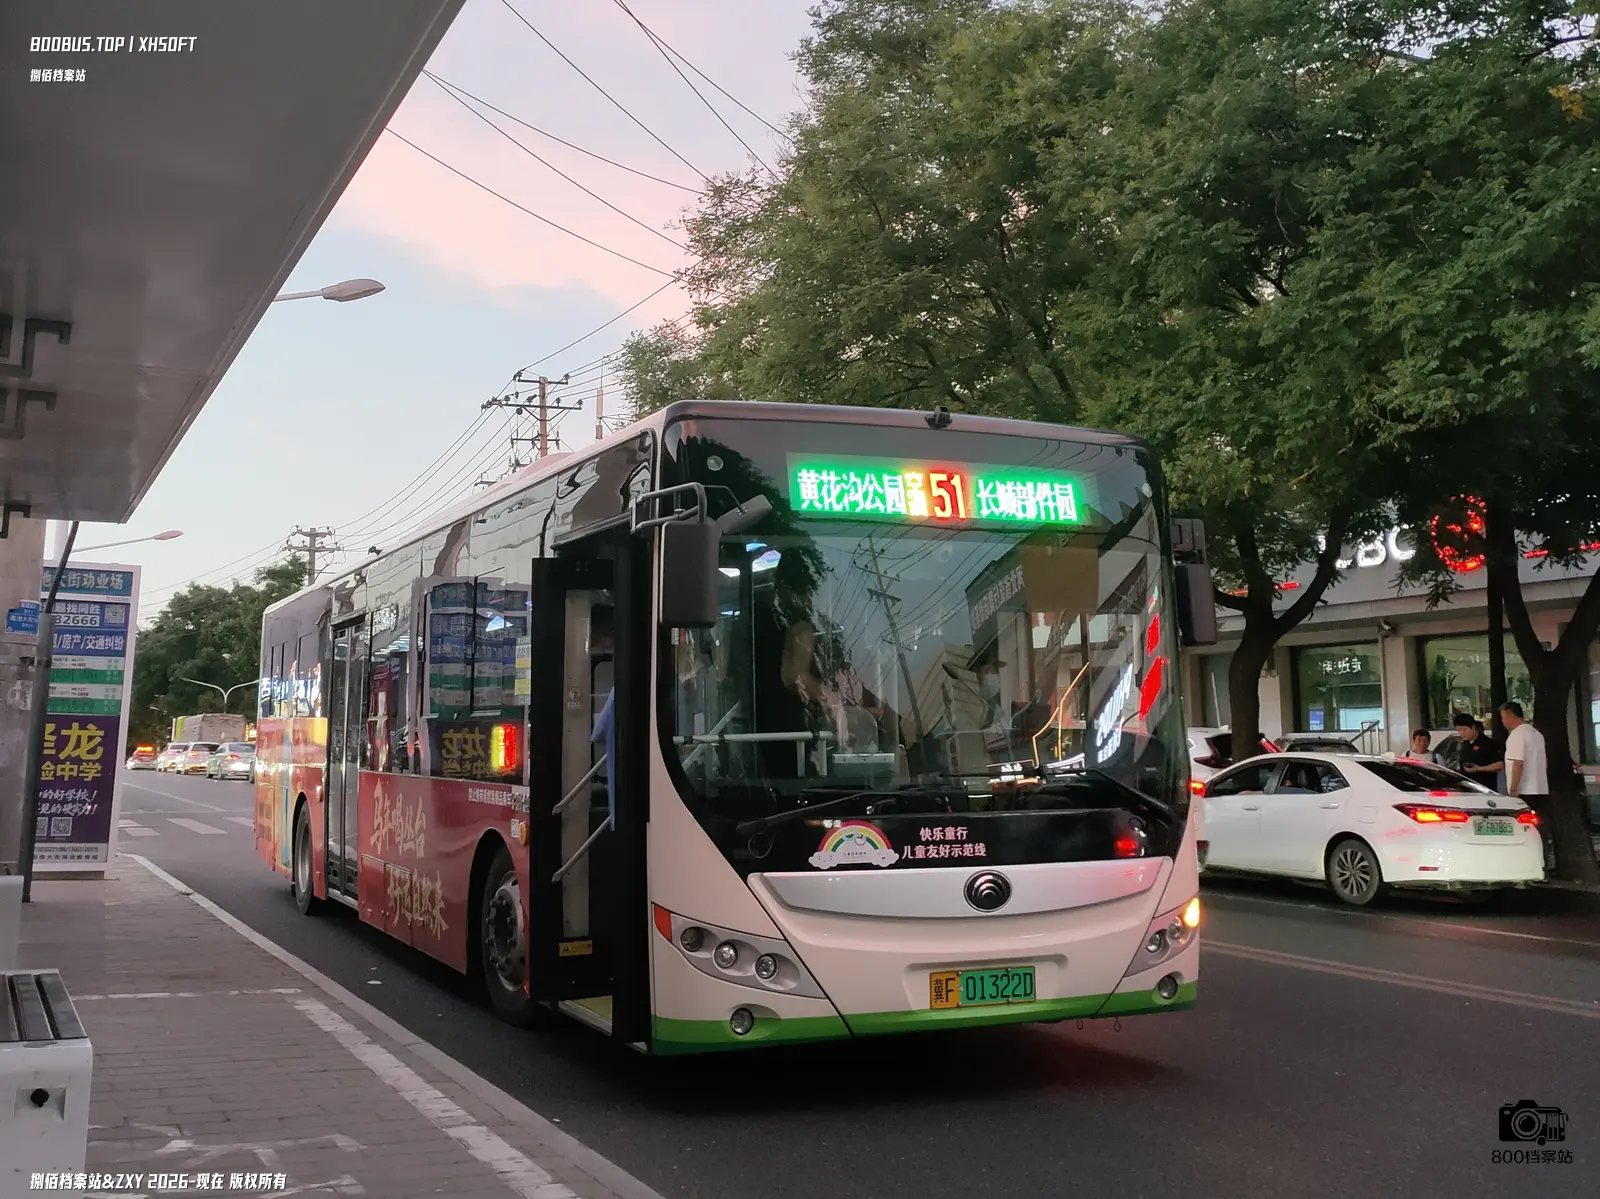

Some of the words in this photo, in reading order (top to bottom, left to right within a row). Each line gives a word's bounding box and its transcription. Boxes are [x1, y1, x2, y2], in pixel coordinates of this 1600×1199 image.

[797, 469, 907, 514] 黄花沟公园
[929, 472, 966, 519] 51
[39, 789, 98, 802] 的好学校!
[38, 803, 98, 816] 见的硬实力!
[919, 827, 968, 841] 快乐童行
[902, 843, 987, 860] 儿童友好示范线
[965, 972, 1034, 1001] 01322D
